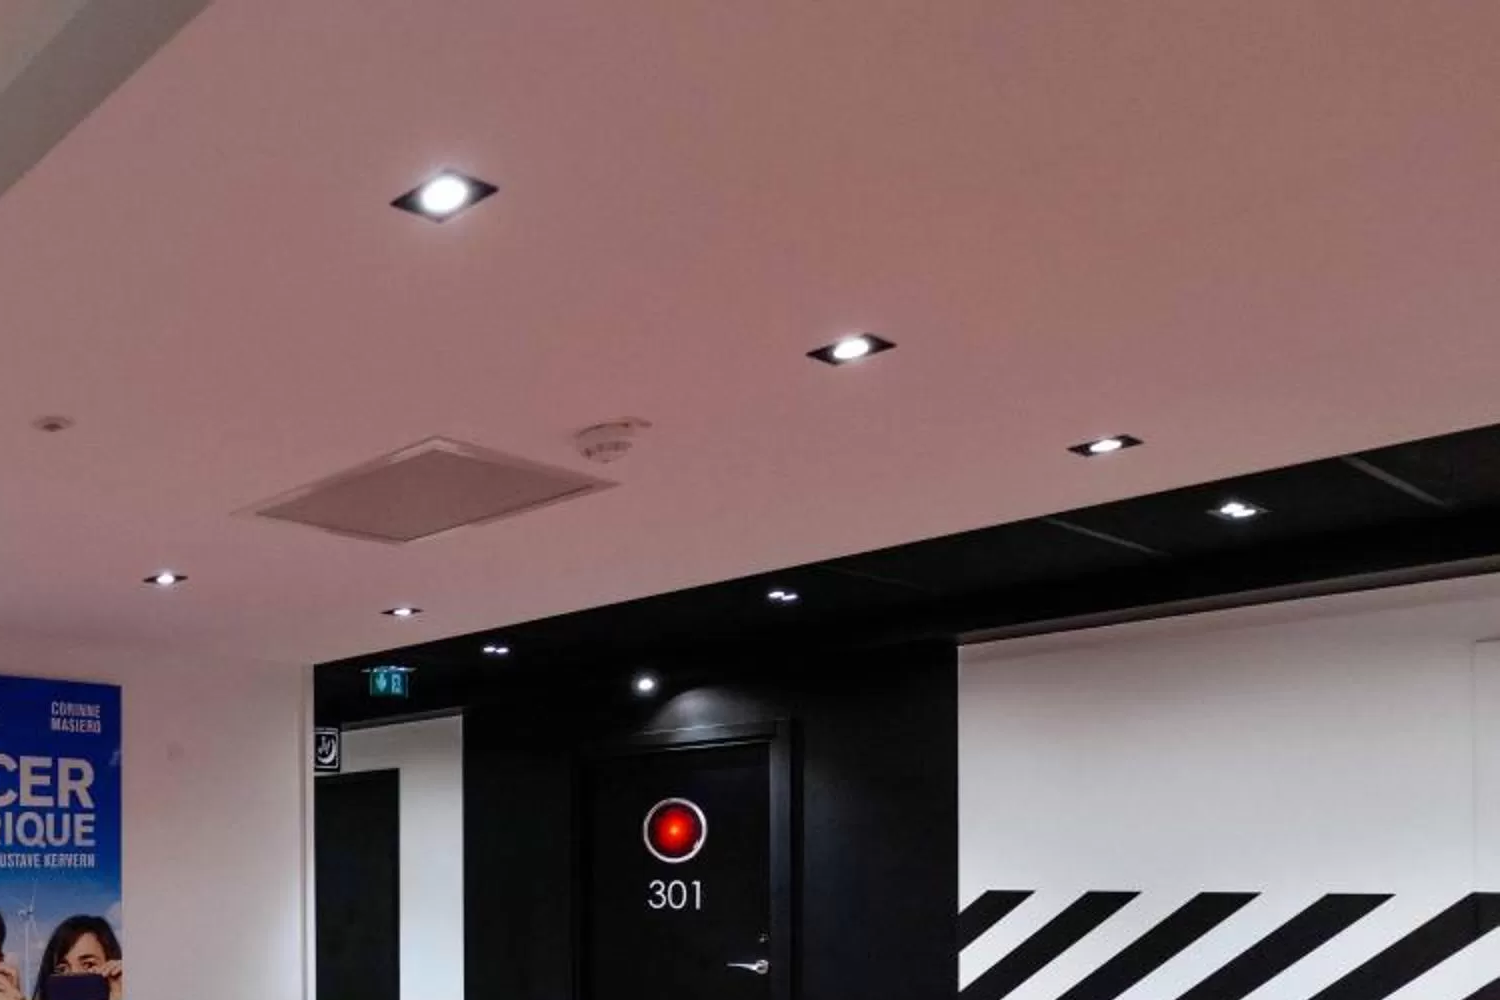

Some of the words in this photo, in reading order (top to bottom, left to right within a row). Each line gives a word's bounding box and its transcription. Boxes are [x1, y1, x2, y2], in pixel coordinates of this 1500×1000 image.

[51, 700, 101, 719] CORINNE
[51, 717, 102, 734] MASIERO
[43, 852, 95, 869] KERVERN
[648, 880, 701, 910] 301
